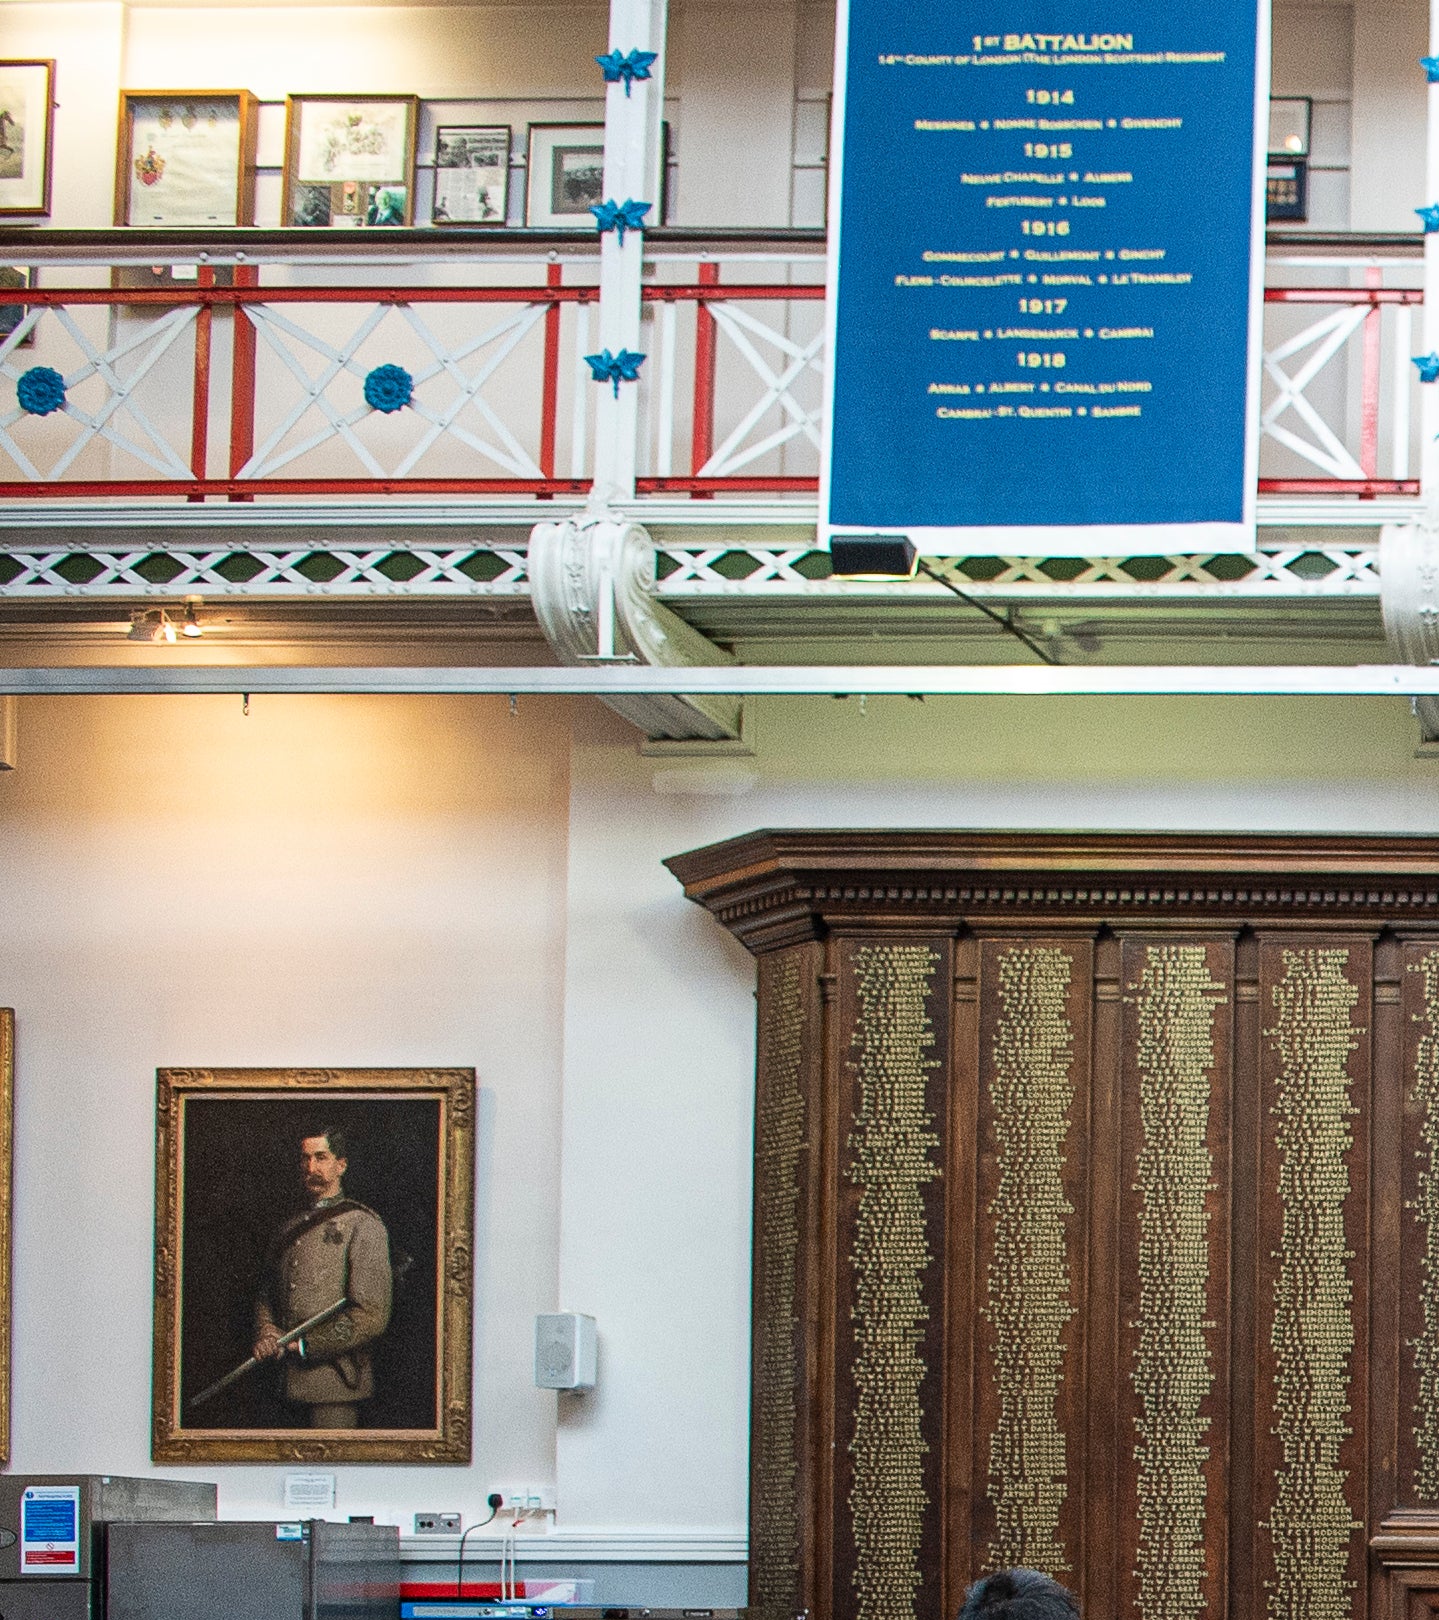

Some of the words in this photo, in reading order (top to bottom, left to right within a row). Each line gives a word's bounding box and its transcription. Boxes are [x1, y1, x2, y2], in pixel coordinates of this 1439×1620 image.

[1004, 34, 1133, 50] BATTALION
[1026, 89, 1074, 104] 1914
[1024, 143, 1072, 158] 1915
[1021, 220, 1070, 235] 1916
[1019, 298, 1067, 313] 1917
[1018, 352, 1066, 367] 1918
